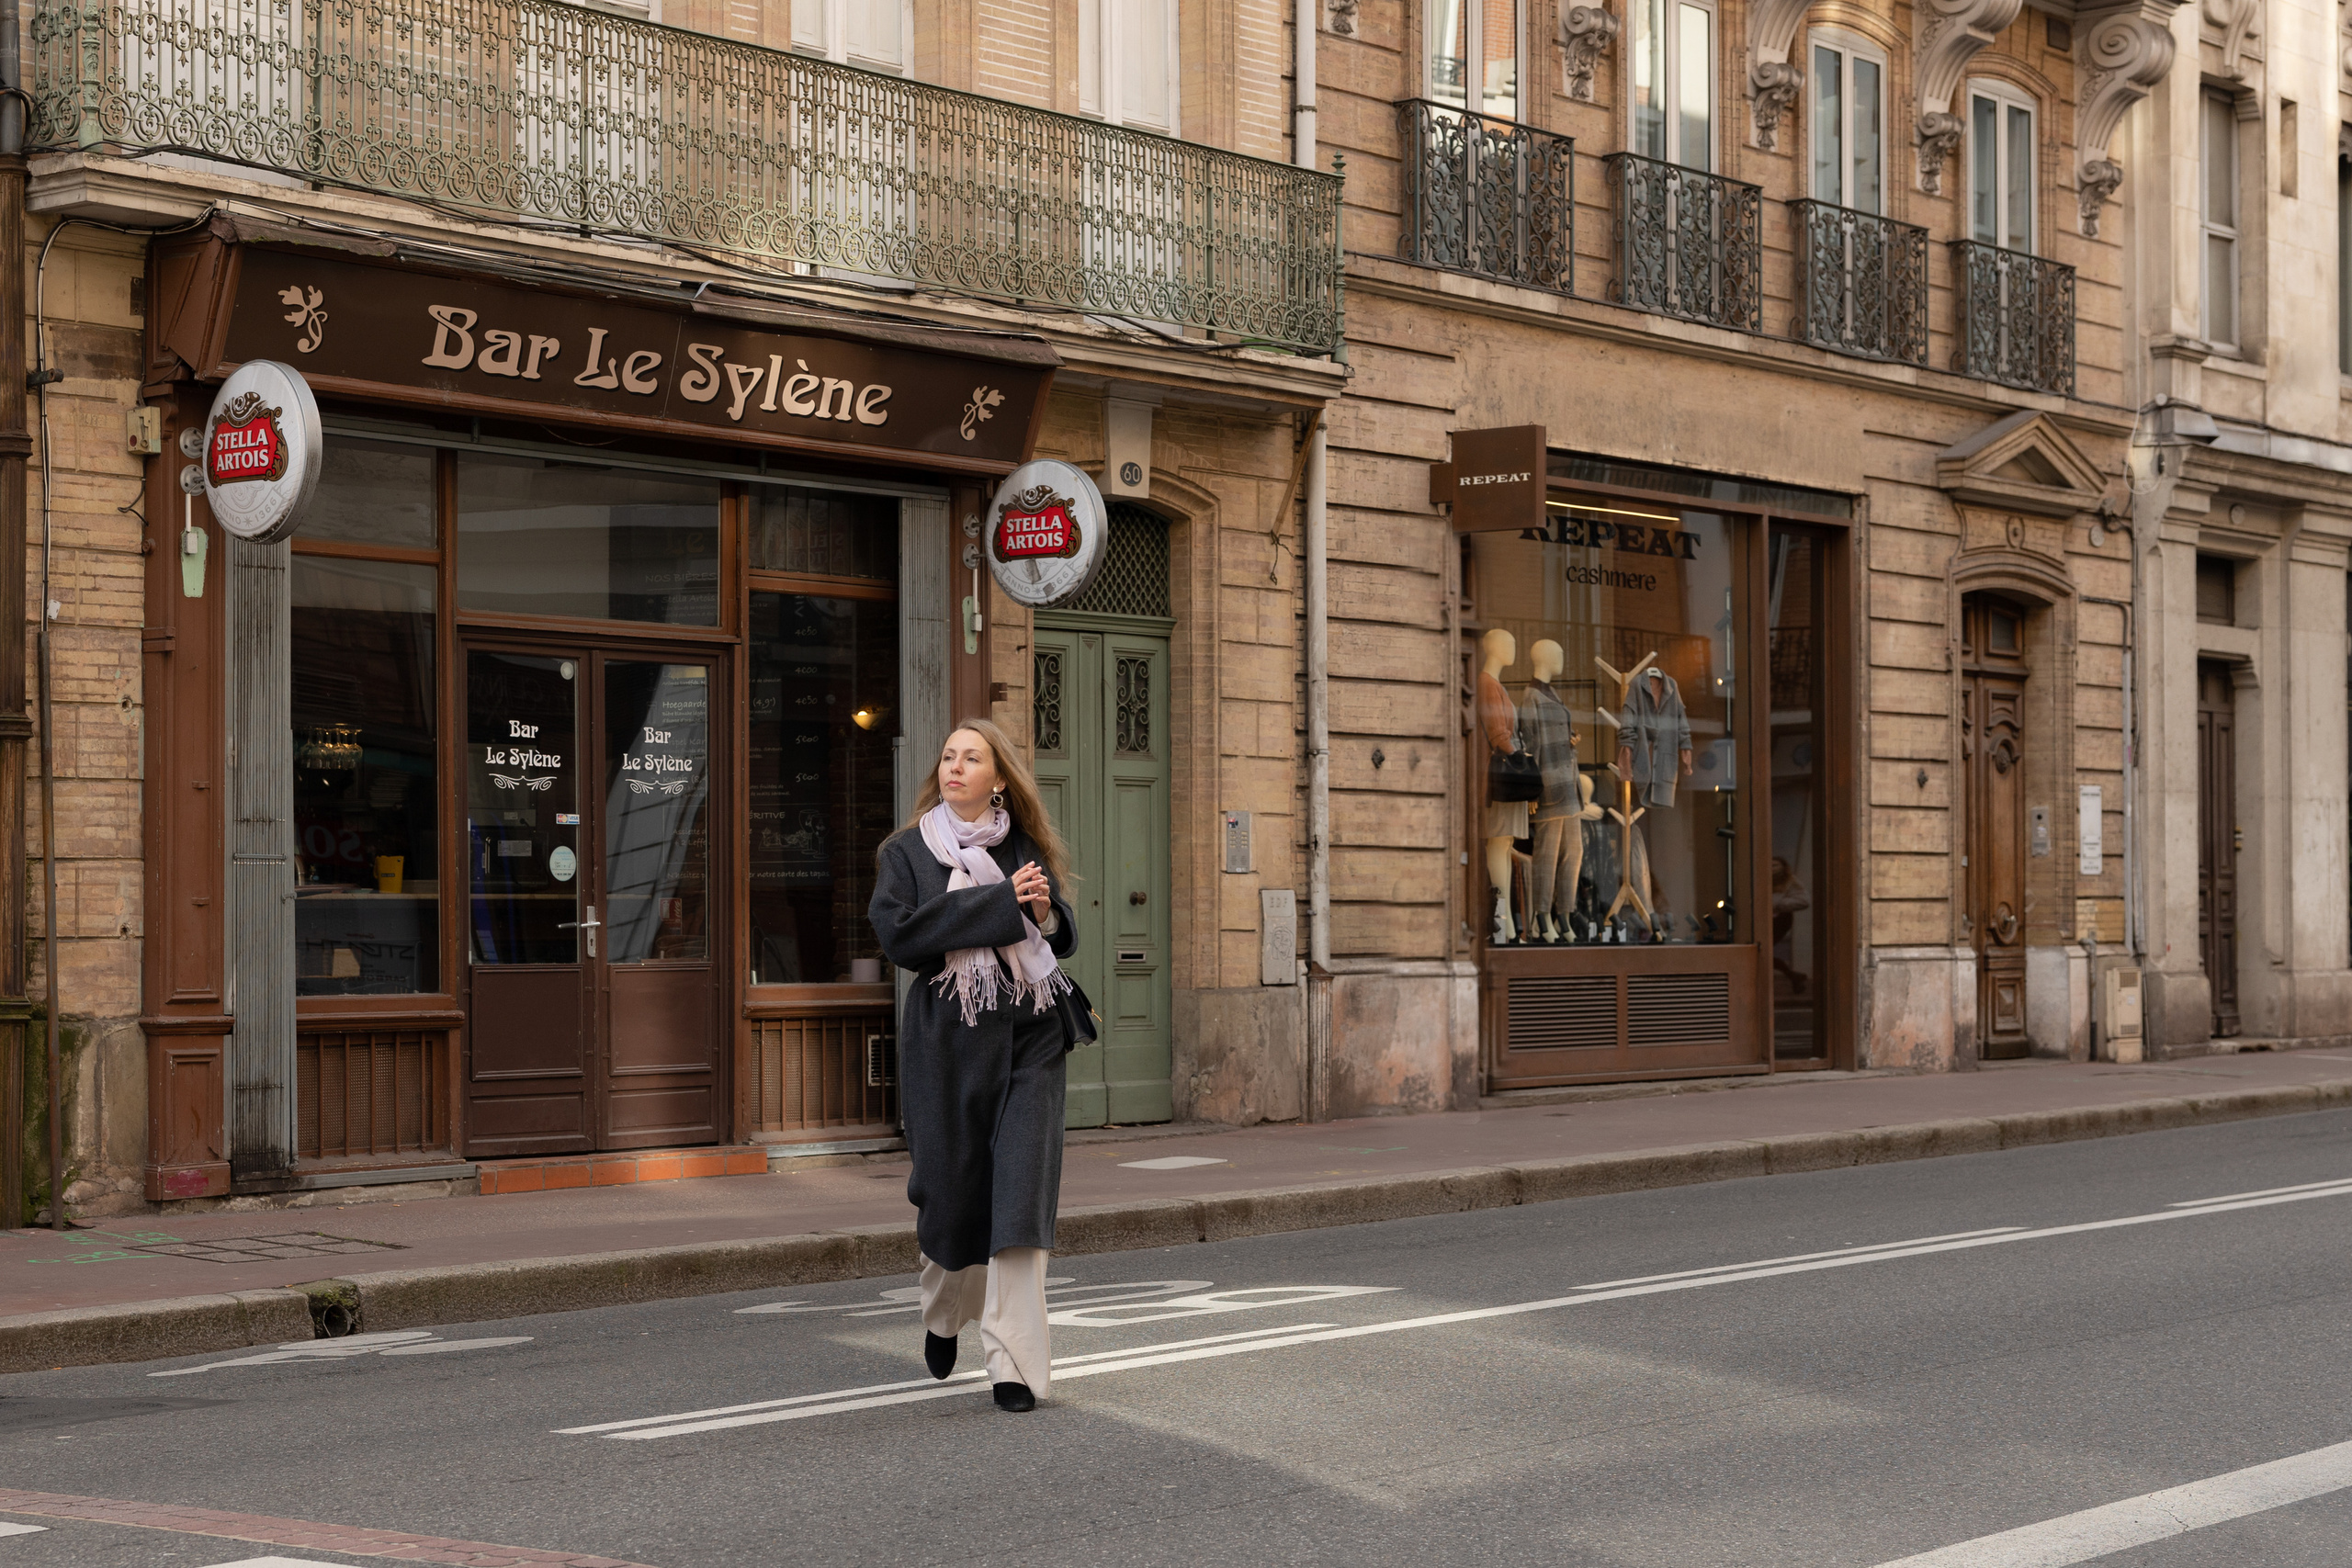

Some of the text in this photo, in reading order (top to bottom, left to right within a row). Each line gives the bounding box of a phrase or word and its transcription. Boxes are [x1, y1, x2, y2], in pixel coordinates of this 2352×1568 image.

[421, 304, 894, 426] Bar Le Sylène
[216, 428, 269, 451] STELLA
[216, 448, 270, 472] ARTOIS
[1124, 465, 1140, 483] 60
[1459, 472, 1531, 486] REPEAT
[218, 496, 277, 525] ANNO 1366
[1006, 514, 1063, 534] STELLA
[1006, 531, 1064, 551] ARTOIS
[645, 570, 718, 583] NOS BIÈRES
[1004, 575, 1031, 594] ANNO
[1566, 564, 1657, 592] cashmere
[661, 593, 716, 604] Stella Artois
[508, 719, 539, 739] Bar
[643, 726, 672, 744] Bar
[485, 746, 561, 771] Le Sylène
[621, 752, 693, 775] Le Sylène
[797, 870, 808, 878] des
[809, 871, 830, 879] tapas
